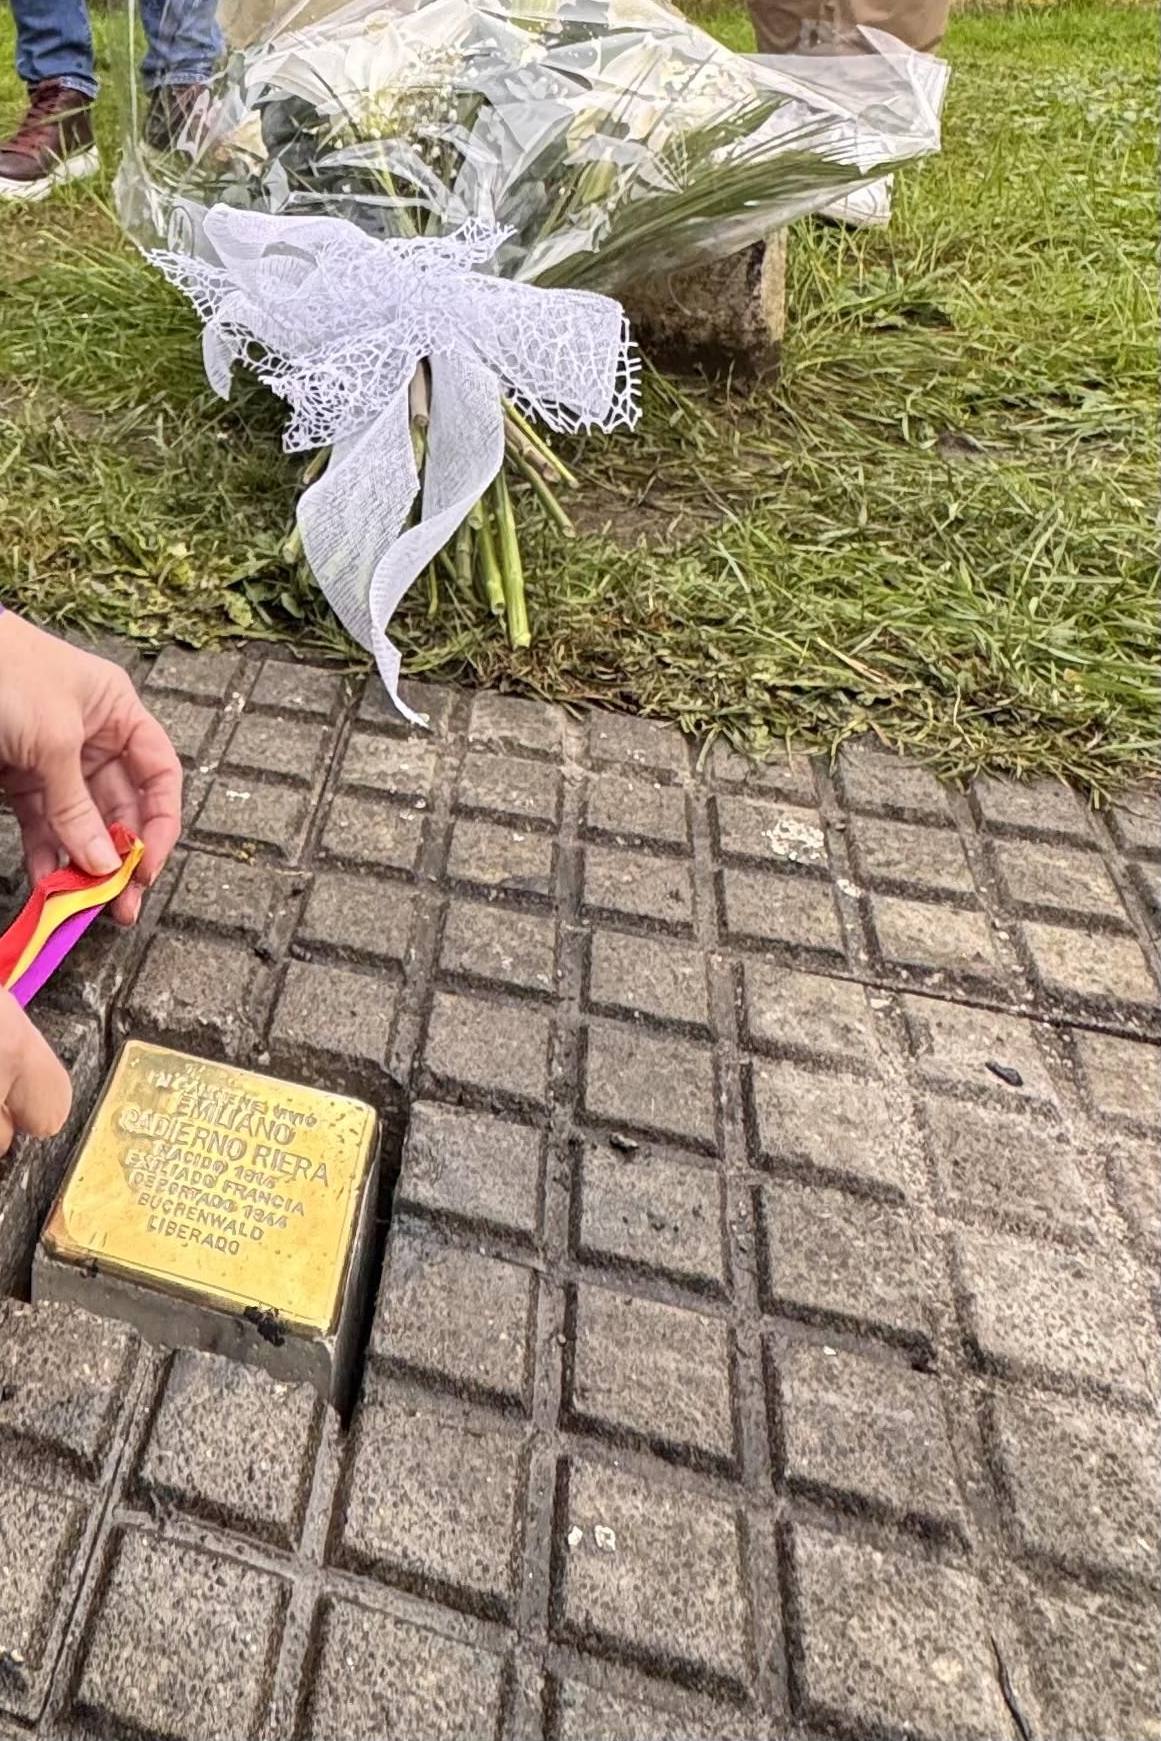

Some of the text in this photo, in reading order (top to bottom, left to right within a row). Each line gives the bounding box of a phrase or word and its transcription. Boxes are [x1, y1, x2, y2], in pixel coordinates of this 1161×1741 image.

[175, 1091, 296, 1146] EMILIANO
[157, 1141, 229, 1174] NACIDO
[252, 1143, 330, 1187] RIERA
[124, 1150, 306, 1217] EXILIADO FRANCIA
[132, 1171, 239, 1214] DEPORTADO
[137, 1192, 265, 1242] BUCHENWALD
[145, 1216, 241, 1257] LIBERADO
